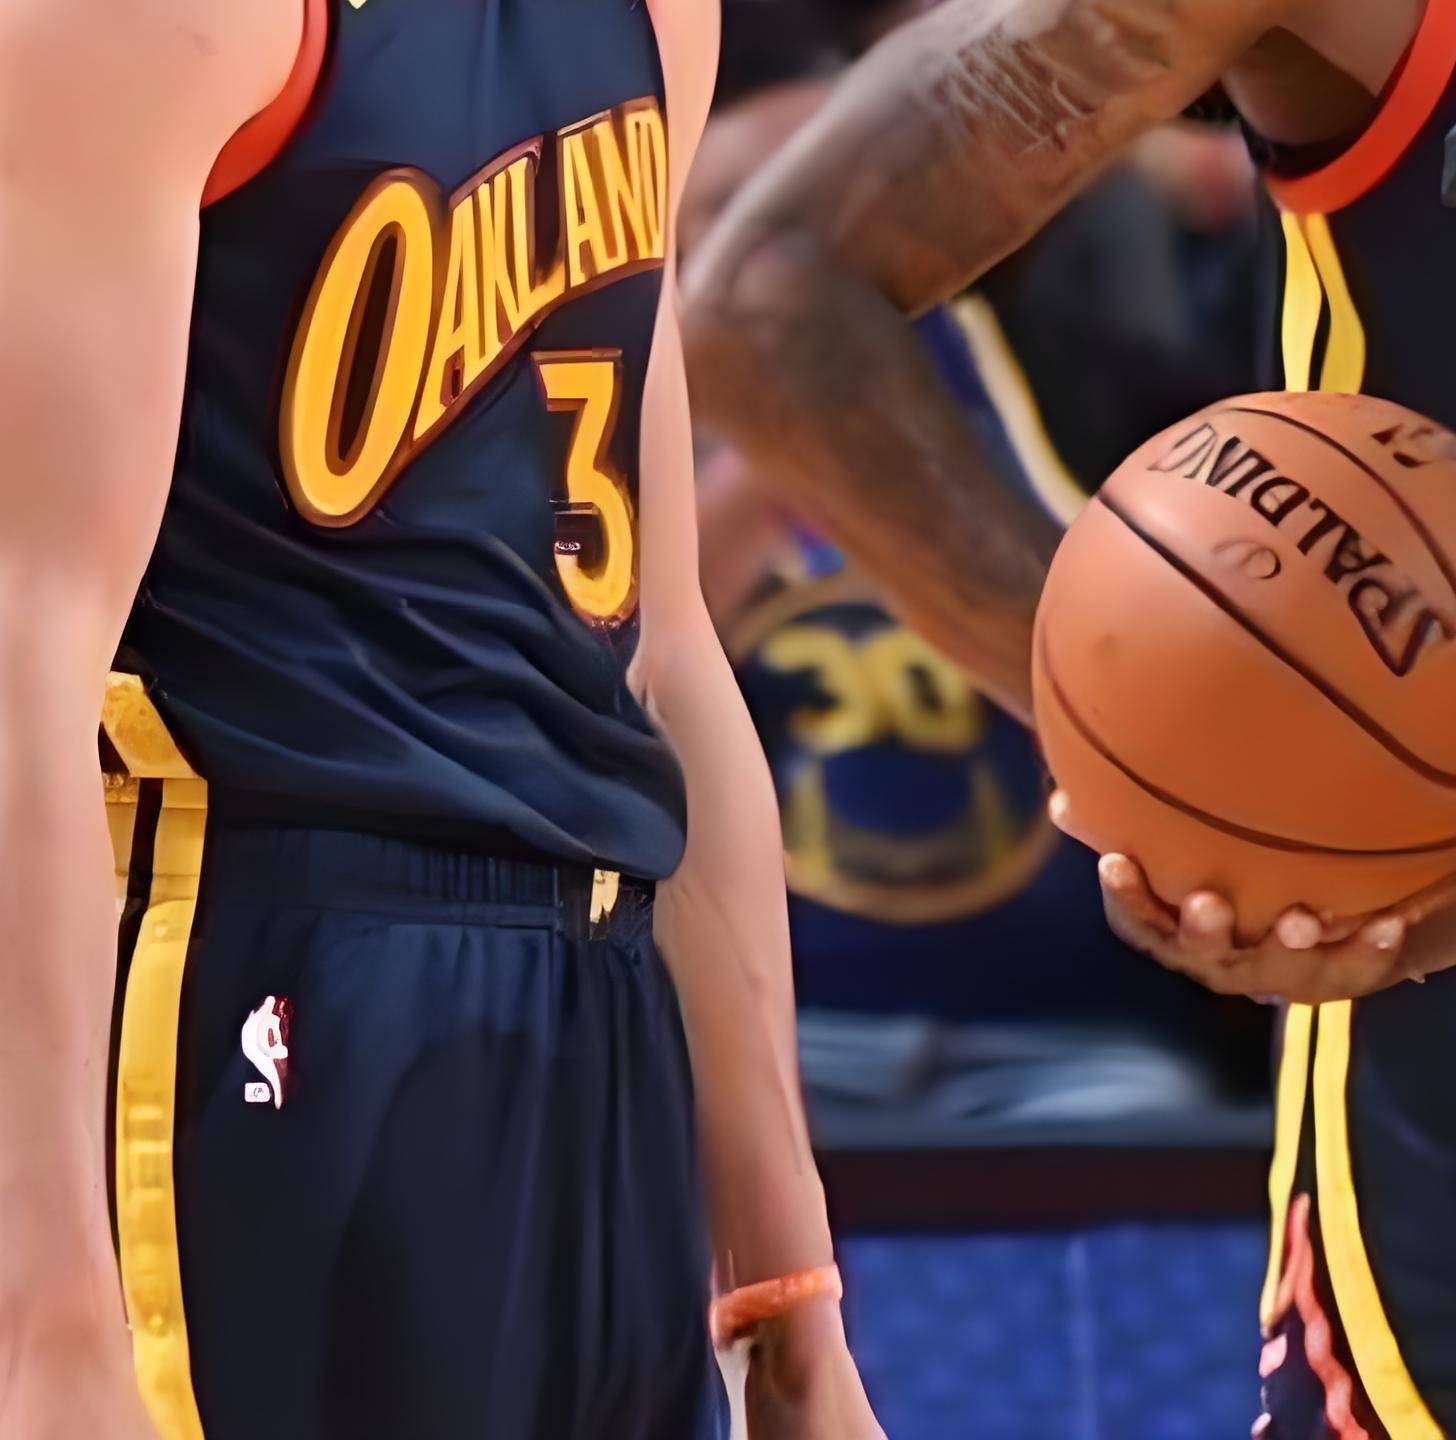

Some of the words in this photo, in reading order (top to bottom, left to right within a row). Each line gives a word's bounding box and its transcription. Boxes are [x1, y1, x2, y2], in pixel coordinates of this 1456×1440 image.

[279, 96, 668, 529] OAKLAND
[1148, 422, 1456, 677] SPALDING
[758, 622, 982, 752] 30
